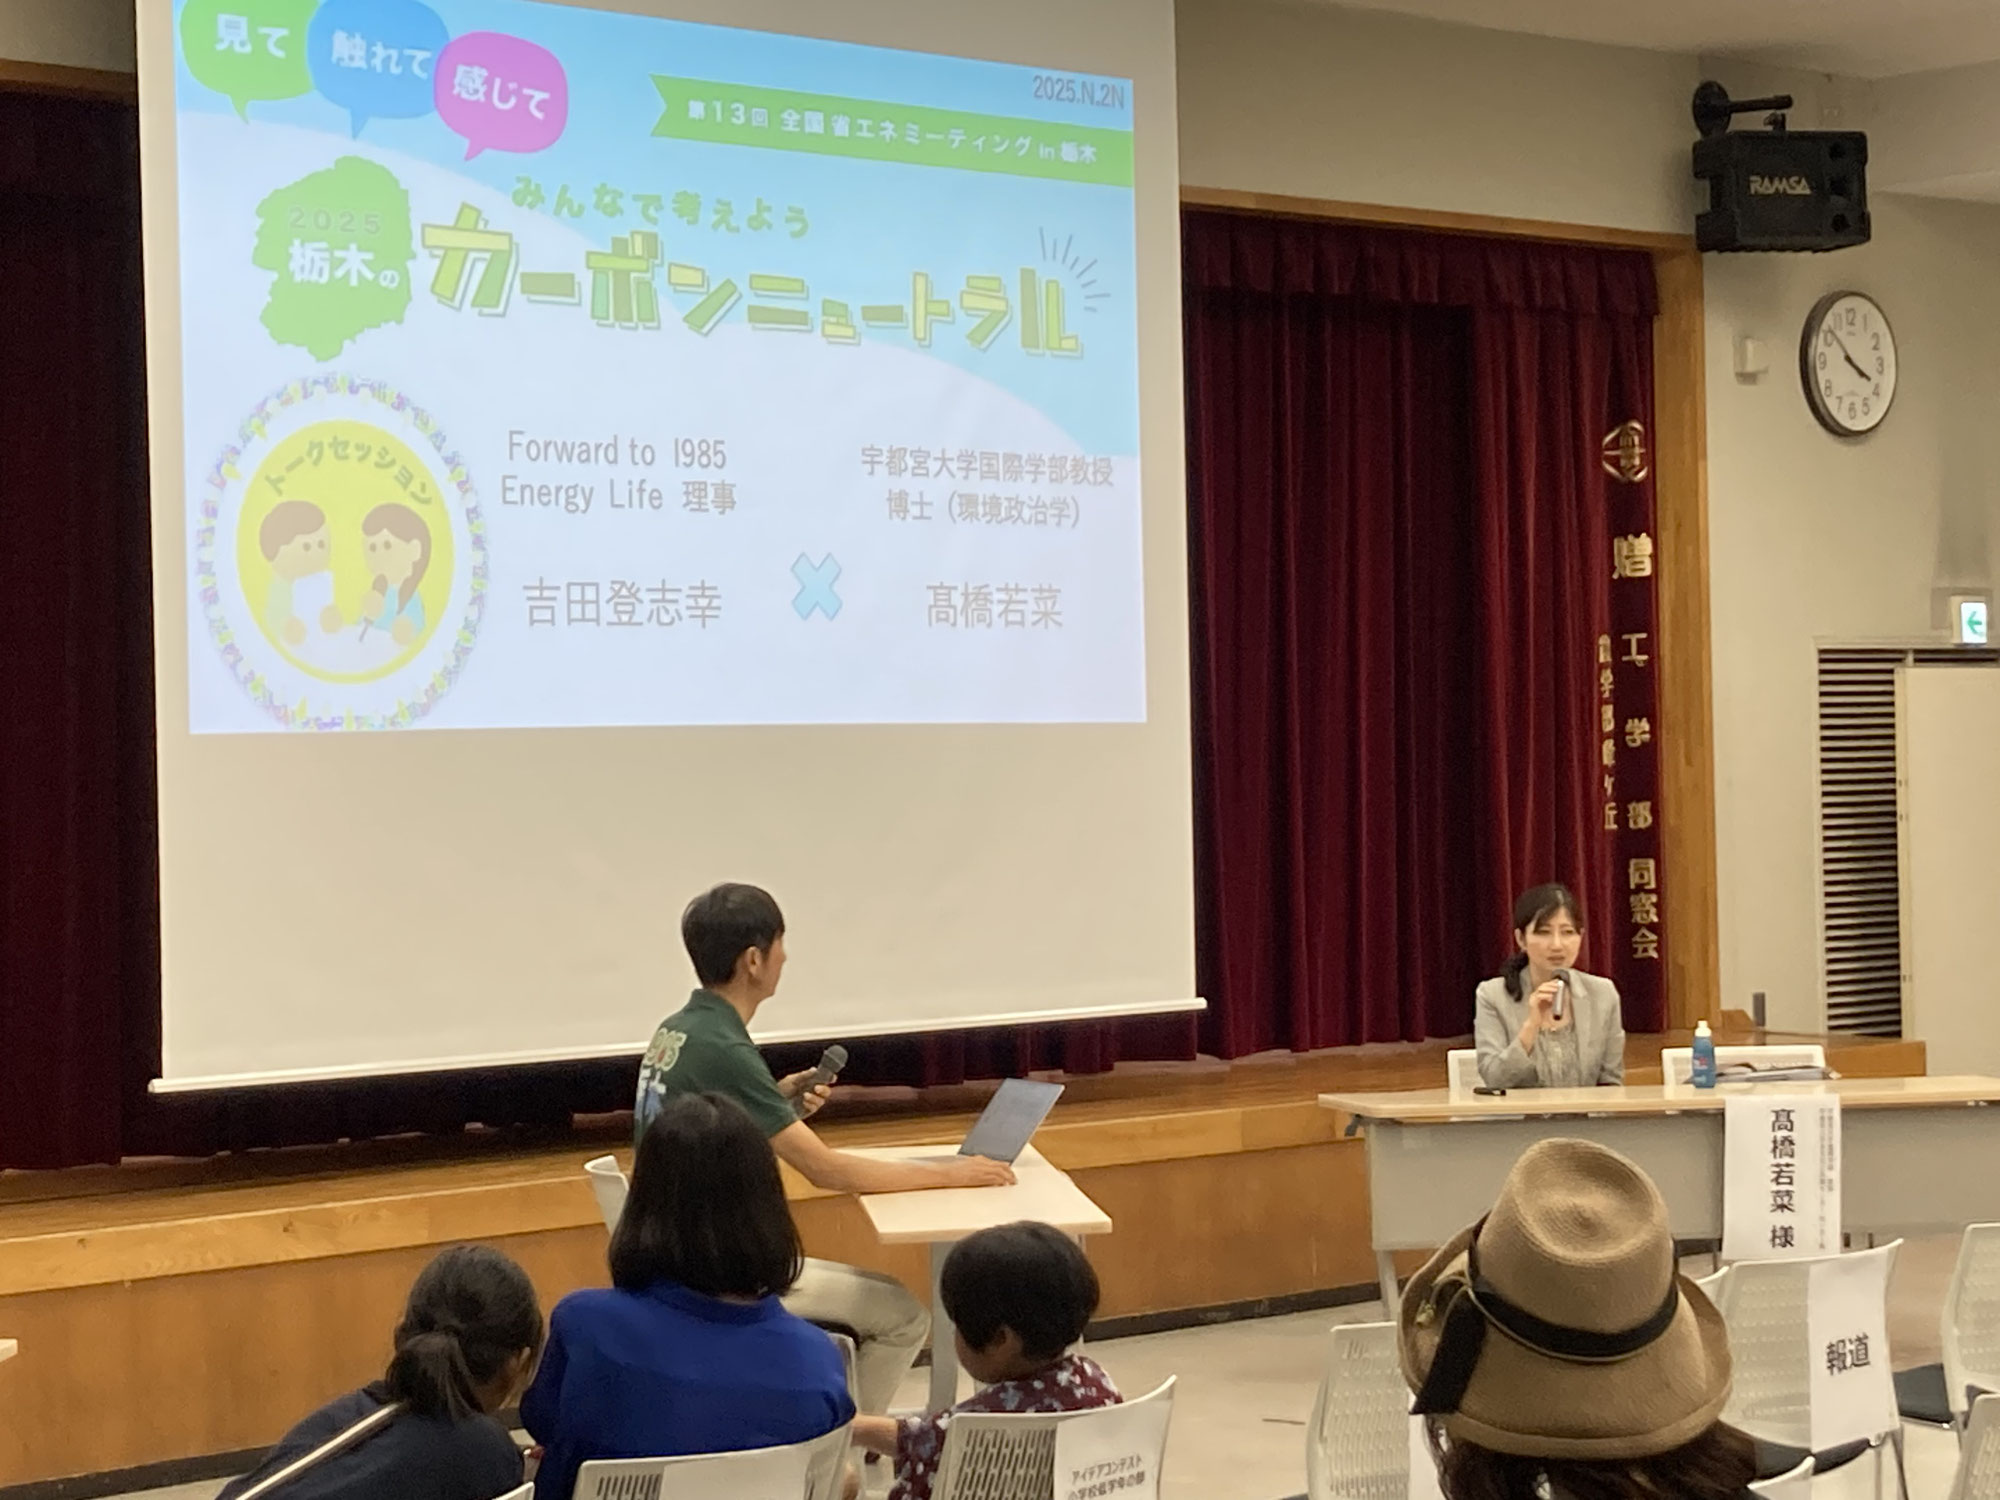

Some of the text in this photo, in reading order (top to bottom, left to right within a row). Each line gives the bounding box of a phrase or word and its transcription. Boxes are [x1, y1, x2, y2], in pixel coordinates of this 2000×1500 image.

[214, 13, 290, 58] 見て
[331, 30, 433, 80] 触れて
[453, 64, 551, 120] 感じて
[1033, 74, 1125, 110] 2025.N.2N
[512, 176, 810, 239] みんなで考えよう
[1750, 175, 1812, 195] RAMSA
[289, 206, 382, 235] 2025
[288, 238, 400, 288] 栃木の
[421, 202, 1085, 358] カーボンニュートラル
[264, 435, 433, 505] トークセッション
[507, 430, 728, 470] Forward to 1985
[861, 444, 1114, 488] 宇都宮大学国際学部教授
[502, 475, 738, 515] Energy Life 理事
[523, 577, 723, 630] 吉田登志幸
[1769, 1225, 1795, 1249] 様
[1826, 1332, 1871, 1377] 報道
[1072, 1455, 1142, 1485] アイデアコンテスト
